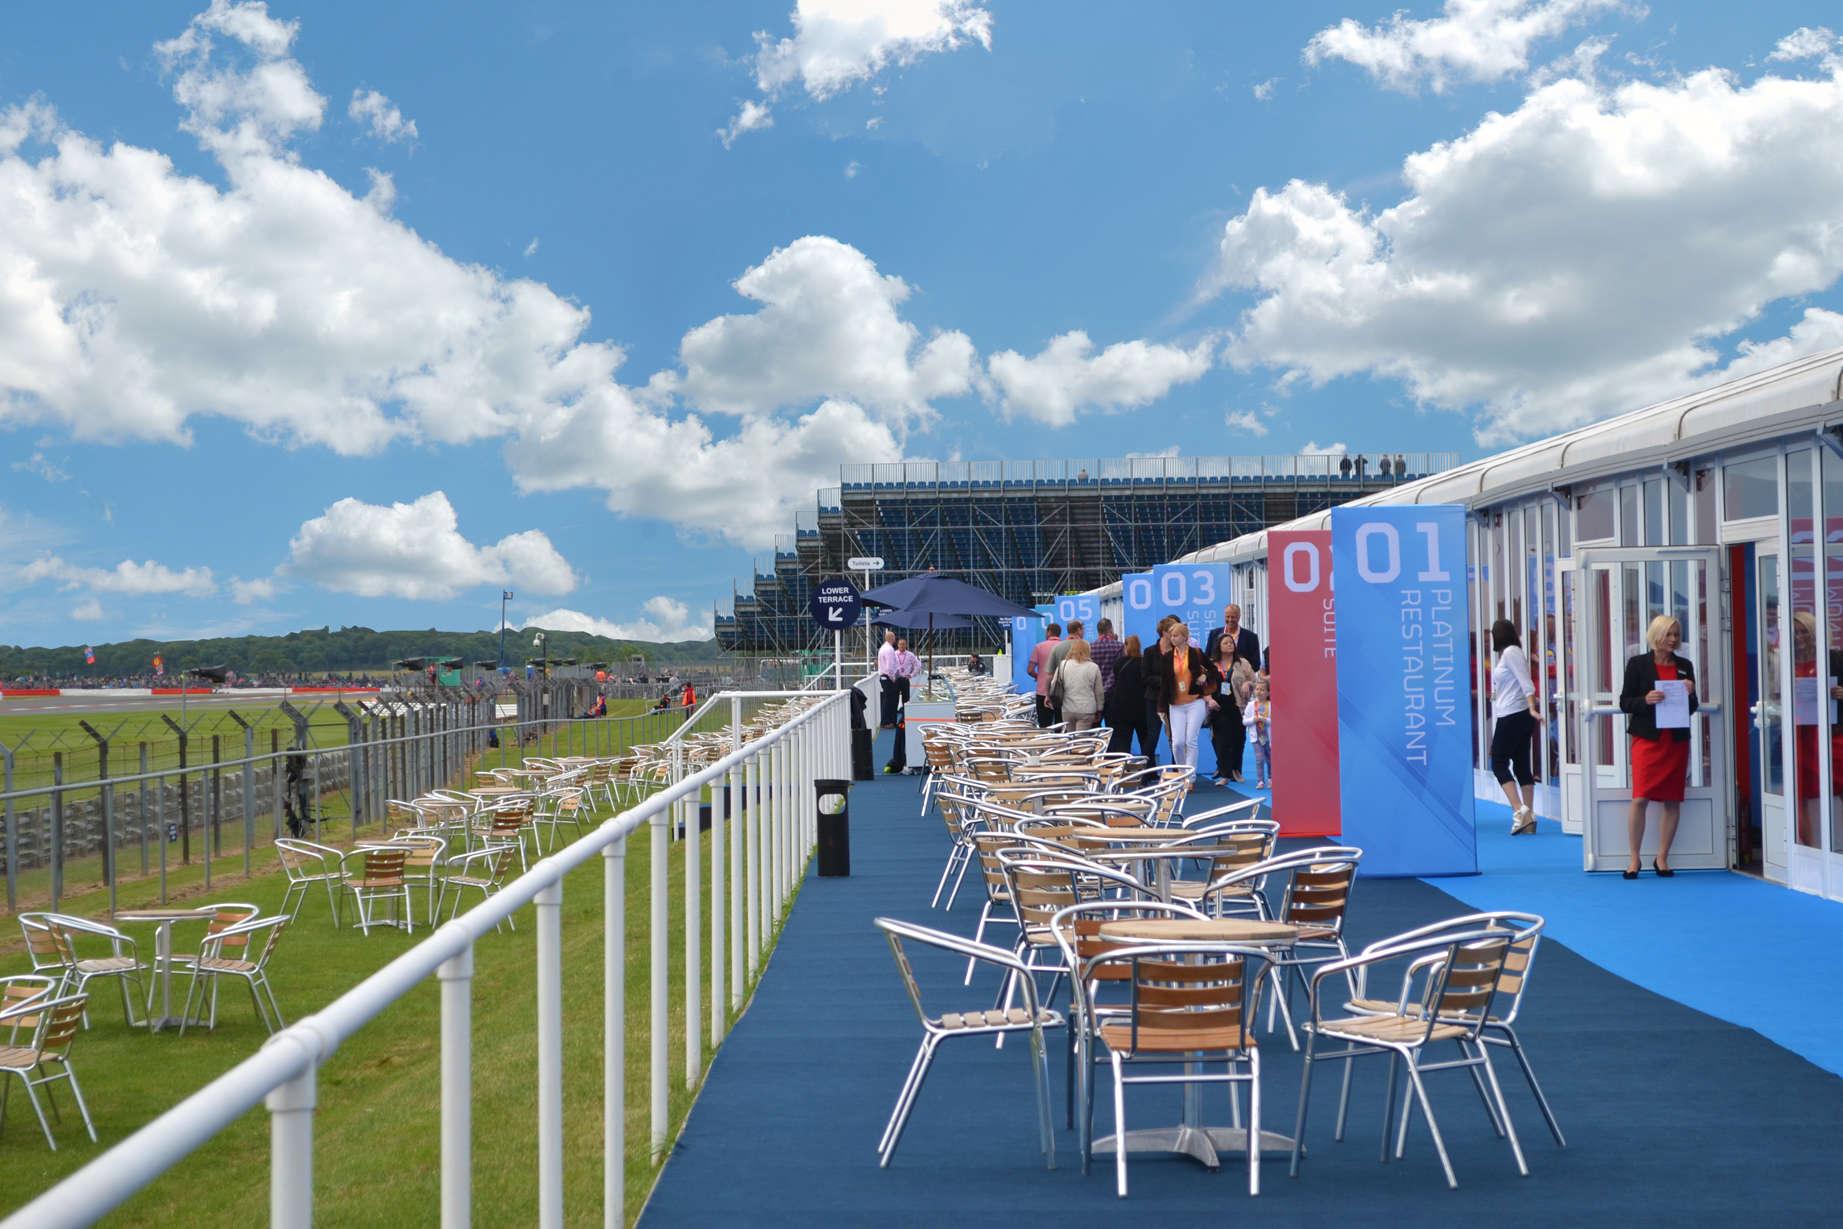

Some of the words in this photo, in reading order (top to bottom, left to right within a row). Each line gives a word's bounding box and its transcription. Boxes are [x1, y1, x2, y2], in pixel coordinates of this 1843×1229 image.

[1355, 522, 1451, 583] 01
[818, 595, 854, 604] TERRACE
[822, 586, 850, 595] LOWER
[1060, 599, 1093, 621] 05
[1161, 570, 1216, 607] 03
[1323, 598, 1337, 659] SUITE
[1400, 590, 1427, 767] RESTAURANT
[1431, 589, 1456, 726] PLATINUM
